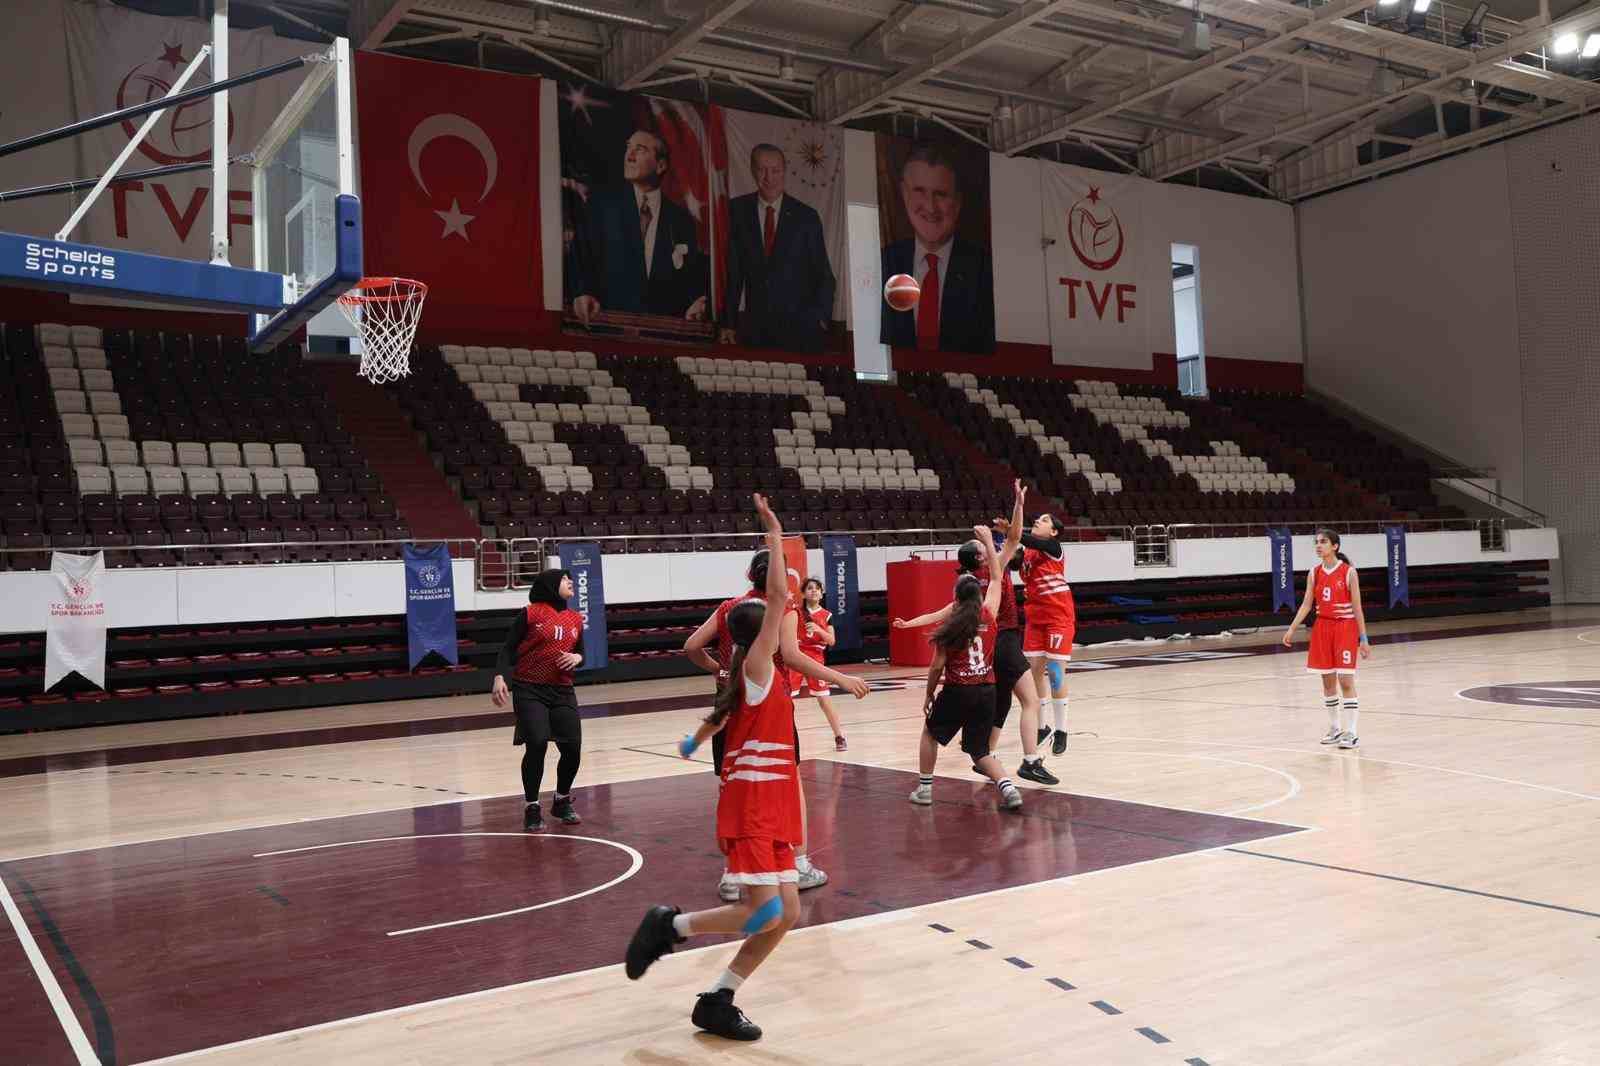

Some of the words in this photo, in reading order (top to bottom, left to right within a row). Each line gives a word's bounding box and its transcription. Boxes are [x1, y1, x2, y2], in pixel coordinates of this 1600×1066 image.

[26, 243, 115, 266] Schelde
[25, 257, 115, 280] Sports
[1059, 277, 1136, 323] TVF
[1392, 543, 1400, 586] VOLEYBOL
[837, 561, 846, 615] VOLEYBOL
[1323, 587, 1332, 601] 9
[554, 625, 563, 641] 11
[1050, 633, 1064, 649] 17
[968, 636, 985, 671] 8
[1342, 650, 1352, 665] 9
